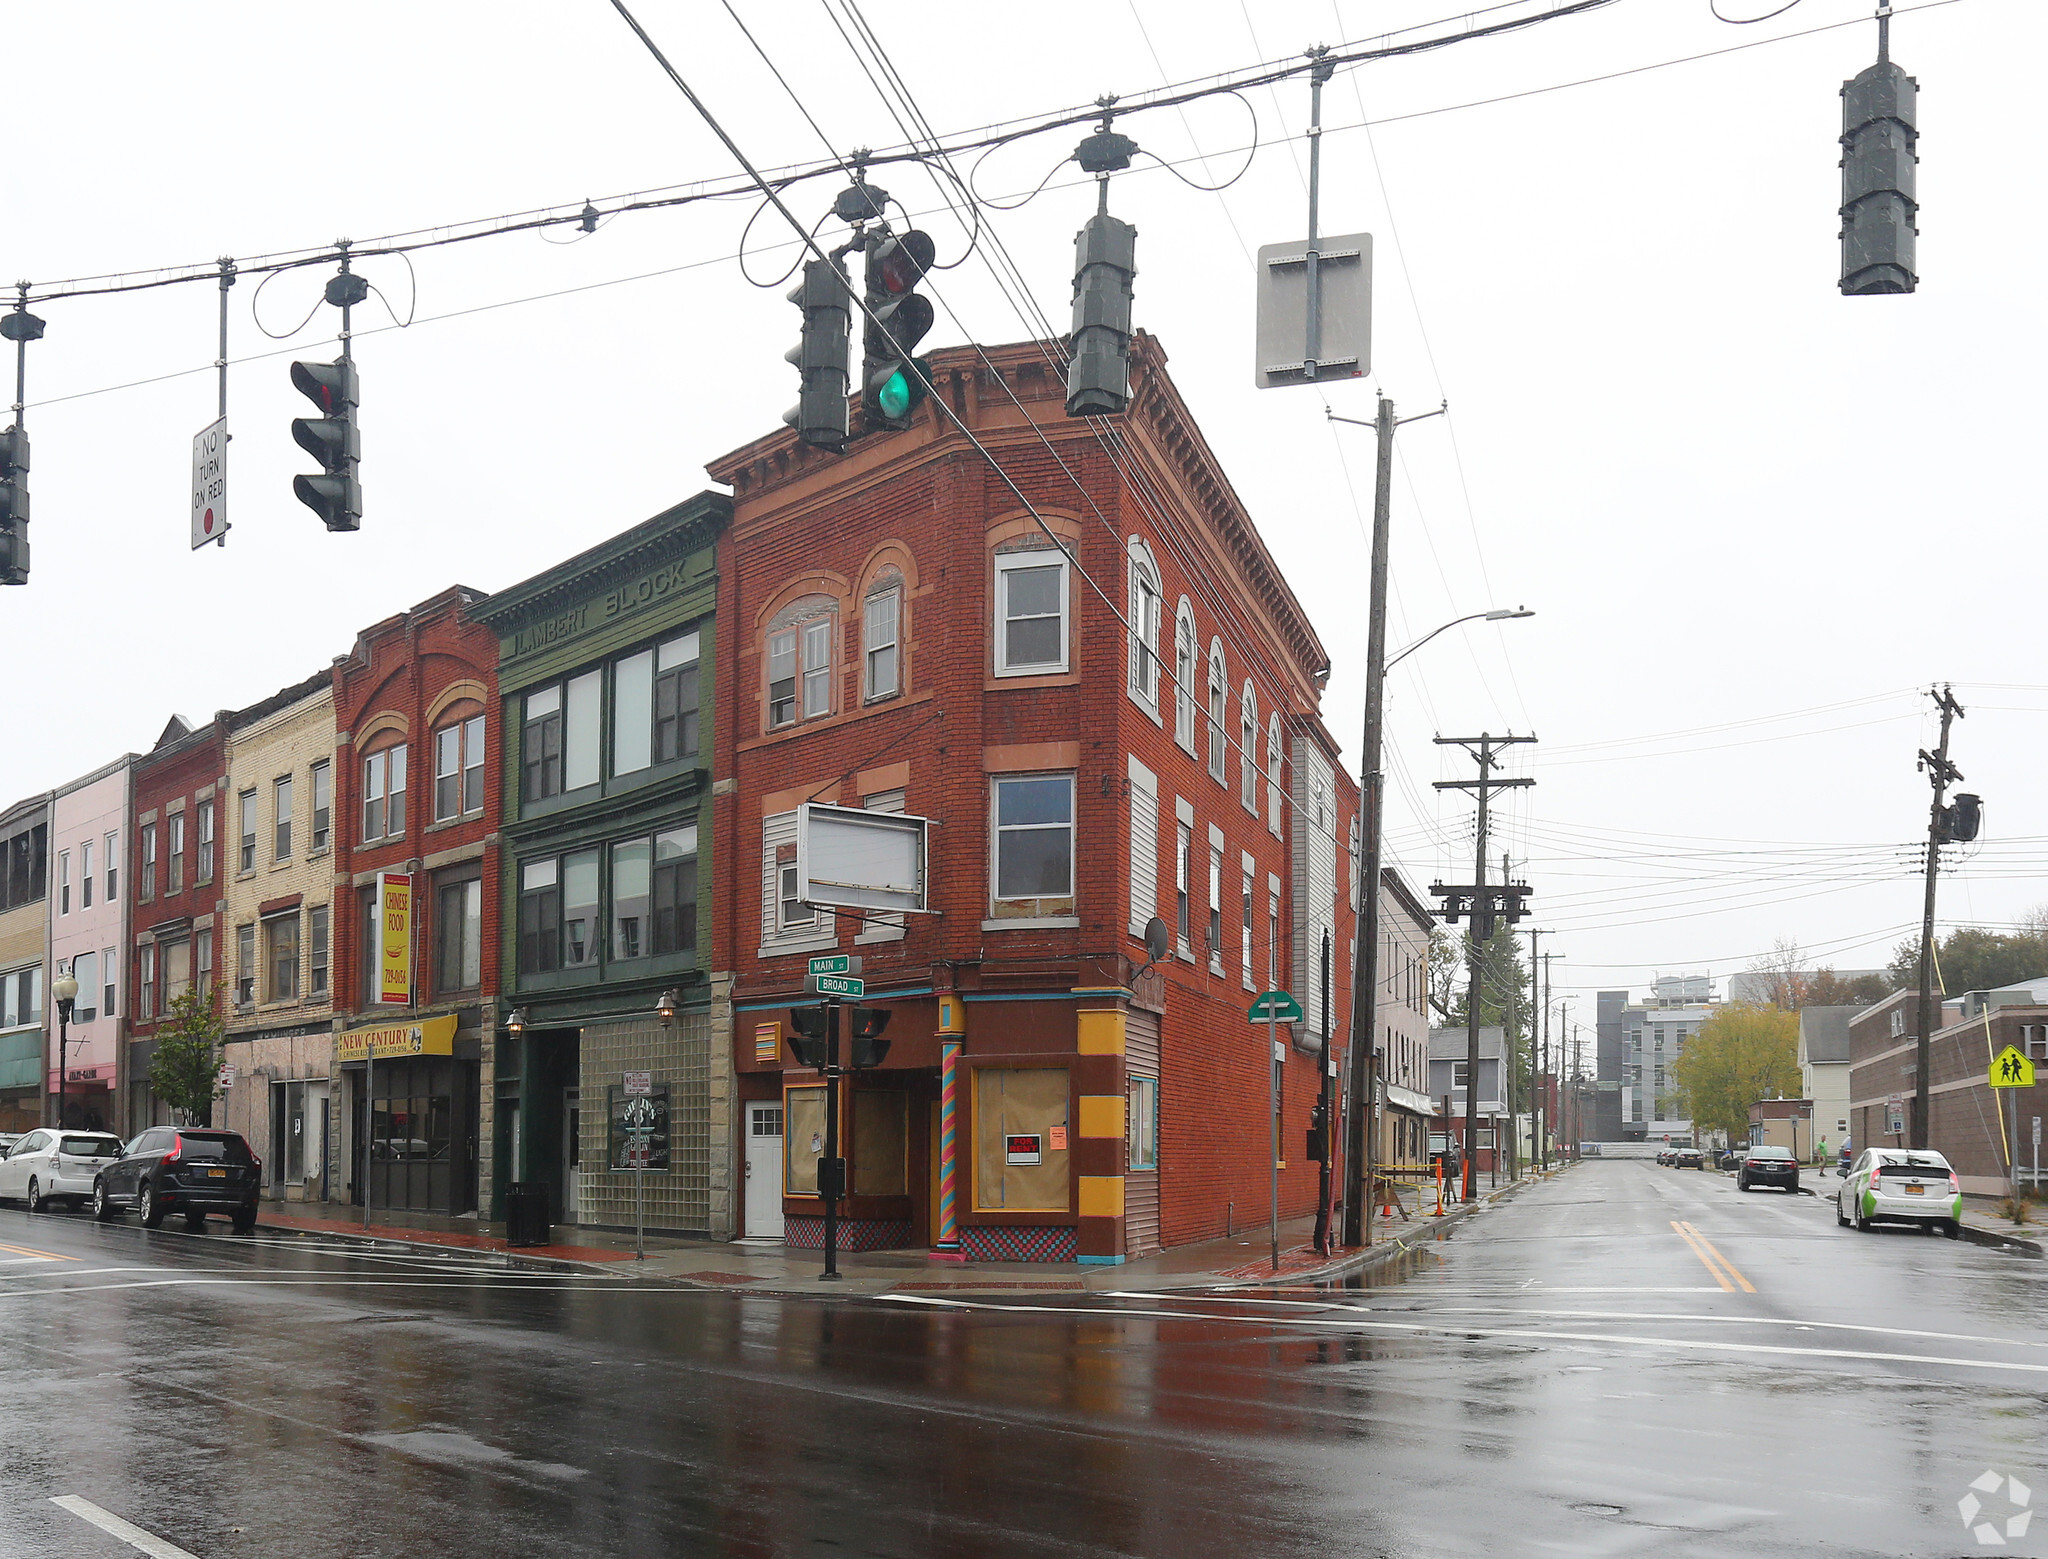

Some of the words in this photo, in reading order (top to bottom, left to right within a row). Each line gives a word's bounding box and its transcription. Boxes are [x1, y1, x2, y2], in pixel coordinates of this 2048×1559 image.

[202, 431, 217, 458] NO
[200, 456, 219, 482] TURN
[195, 488, 206, 509] ON
[208, 479, 223, 501] RED
[519, 603, 588, 656] LAMBERT
[605, 559, 687, 618] BLOCK
[385, 891, 408, 911] CHINESE
[388, 914, 404, 932] FOOD
[813, 960, 834, 972] MAIN
[823, 979, 848, 991] BROAD
[343, 1034, 363, 1050] NEW
[365, 1028, 408, 1047] CENTURY
[1014, 1137, 1033, 1145] FOR
